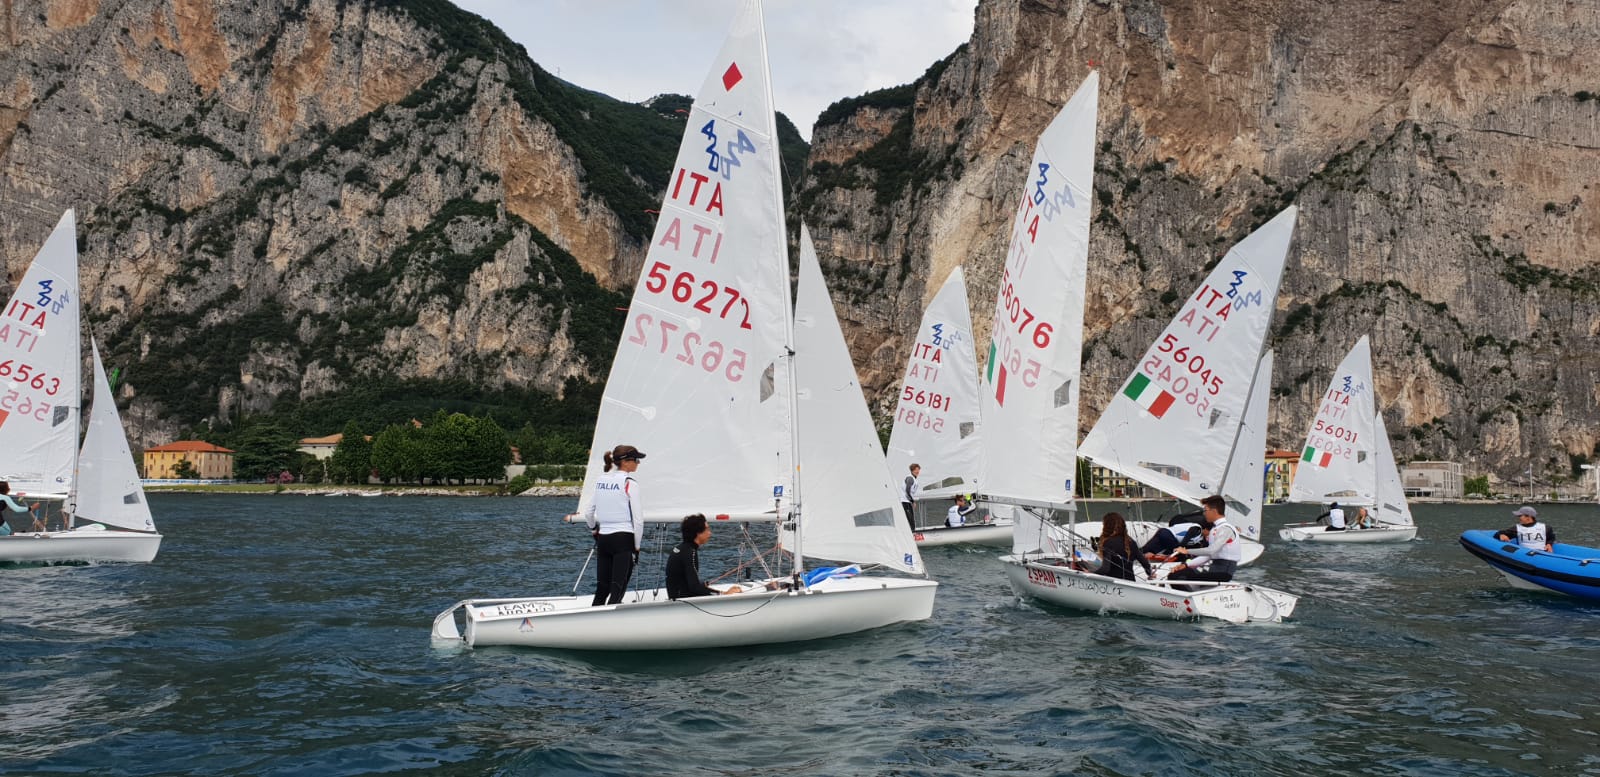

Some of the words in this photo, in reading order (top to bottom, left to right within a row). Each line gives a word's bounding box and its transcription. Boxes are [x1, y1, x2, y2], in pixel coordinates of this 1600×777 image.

[672, 168, 723, 216] ITA
[1020, 188, 1040, 244] ITA
[645, 261, 752, 330] 56272
[1001, 269, 1054, 349] 56076
[1195, 284, 1232, 321] ITA
[7, 299, 46, 330] ITA
[914, 343, 942, 364] ITA
[1157, 333, 1224, 396] 56045
[902, 386, 951, 412] 56181
[1327, 389, 1350, 406] ITA
[1314, 420, 1358, 443] 56031
[1520, 532, 1544, 542] ITA
